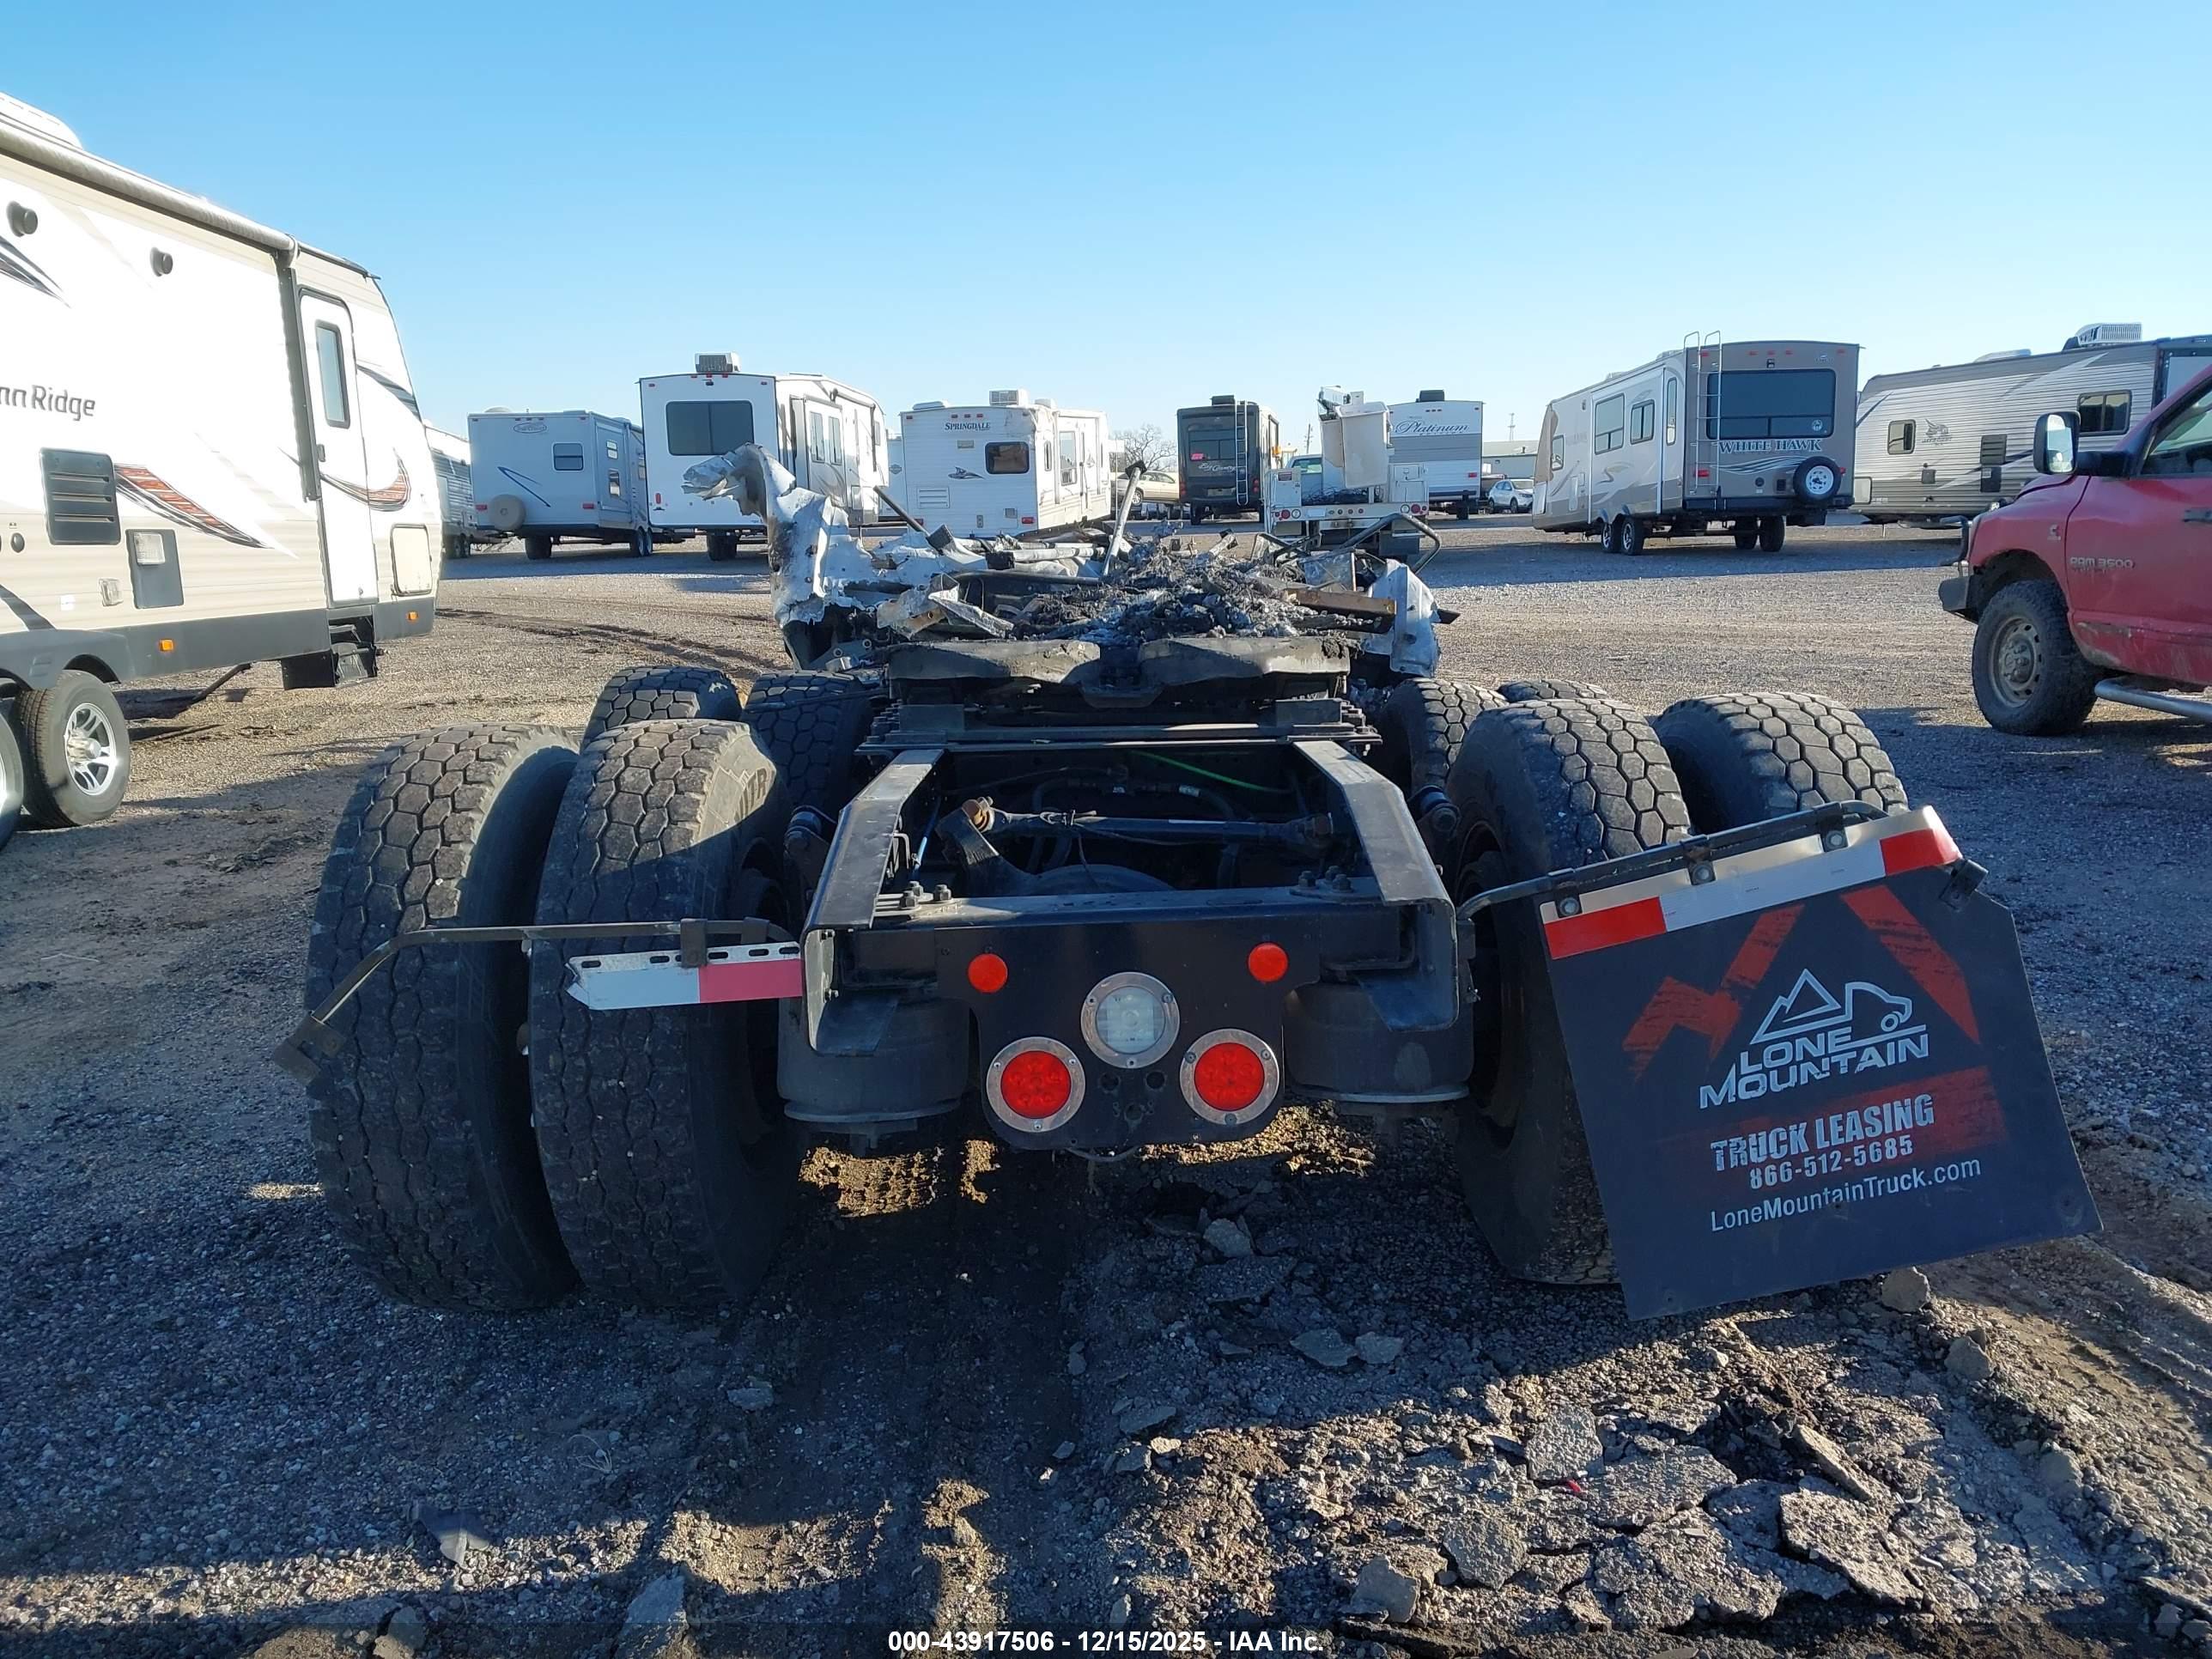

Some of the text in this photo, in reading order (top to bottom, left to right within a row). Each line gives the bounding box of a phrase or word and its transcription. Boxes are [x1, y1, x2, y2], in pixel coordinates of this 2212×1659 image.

[32, 385, 95, 421] Ridge
[945, 422, 990, 430] SPRINGDALE
[1395, 420, 1469, 434] Platinum
[1717, 438, 1822, 453] WHITE HAWK
[1699, 1033, 1929, 1109] MOUNTAIN
[1740, 1026, 1852, 1075] LONE
[1711, 1093, 1936, 1171] TRUCK LEASING
[1749, 1135, 1914, 1189] 866-512-5685
[1711, 1159, 1982, 1231] LoneMountainTruck.com
